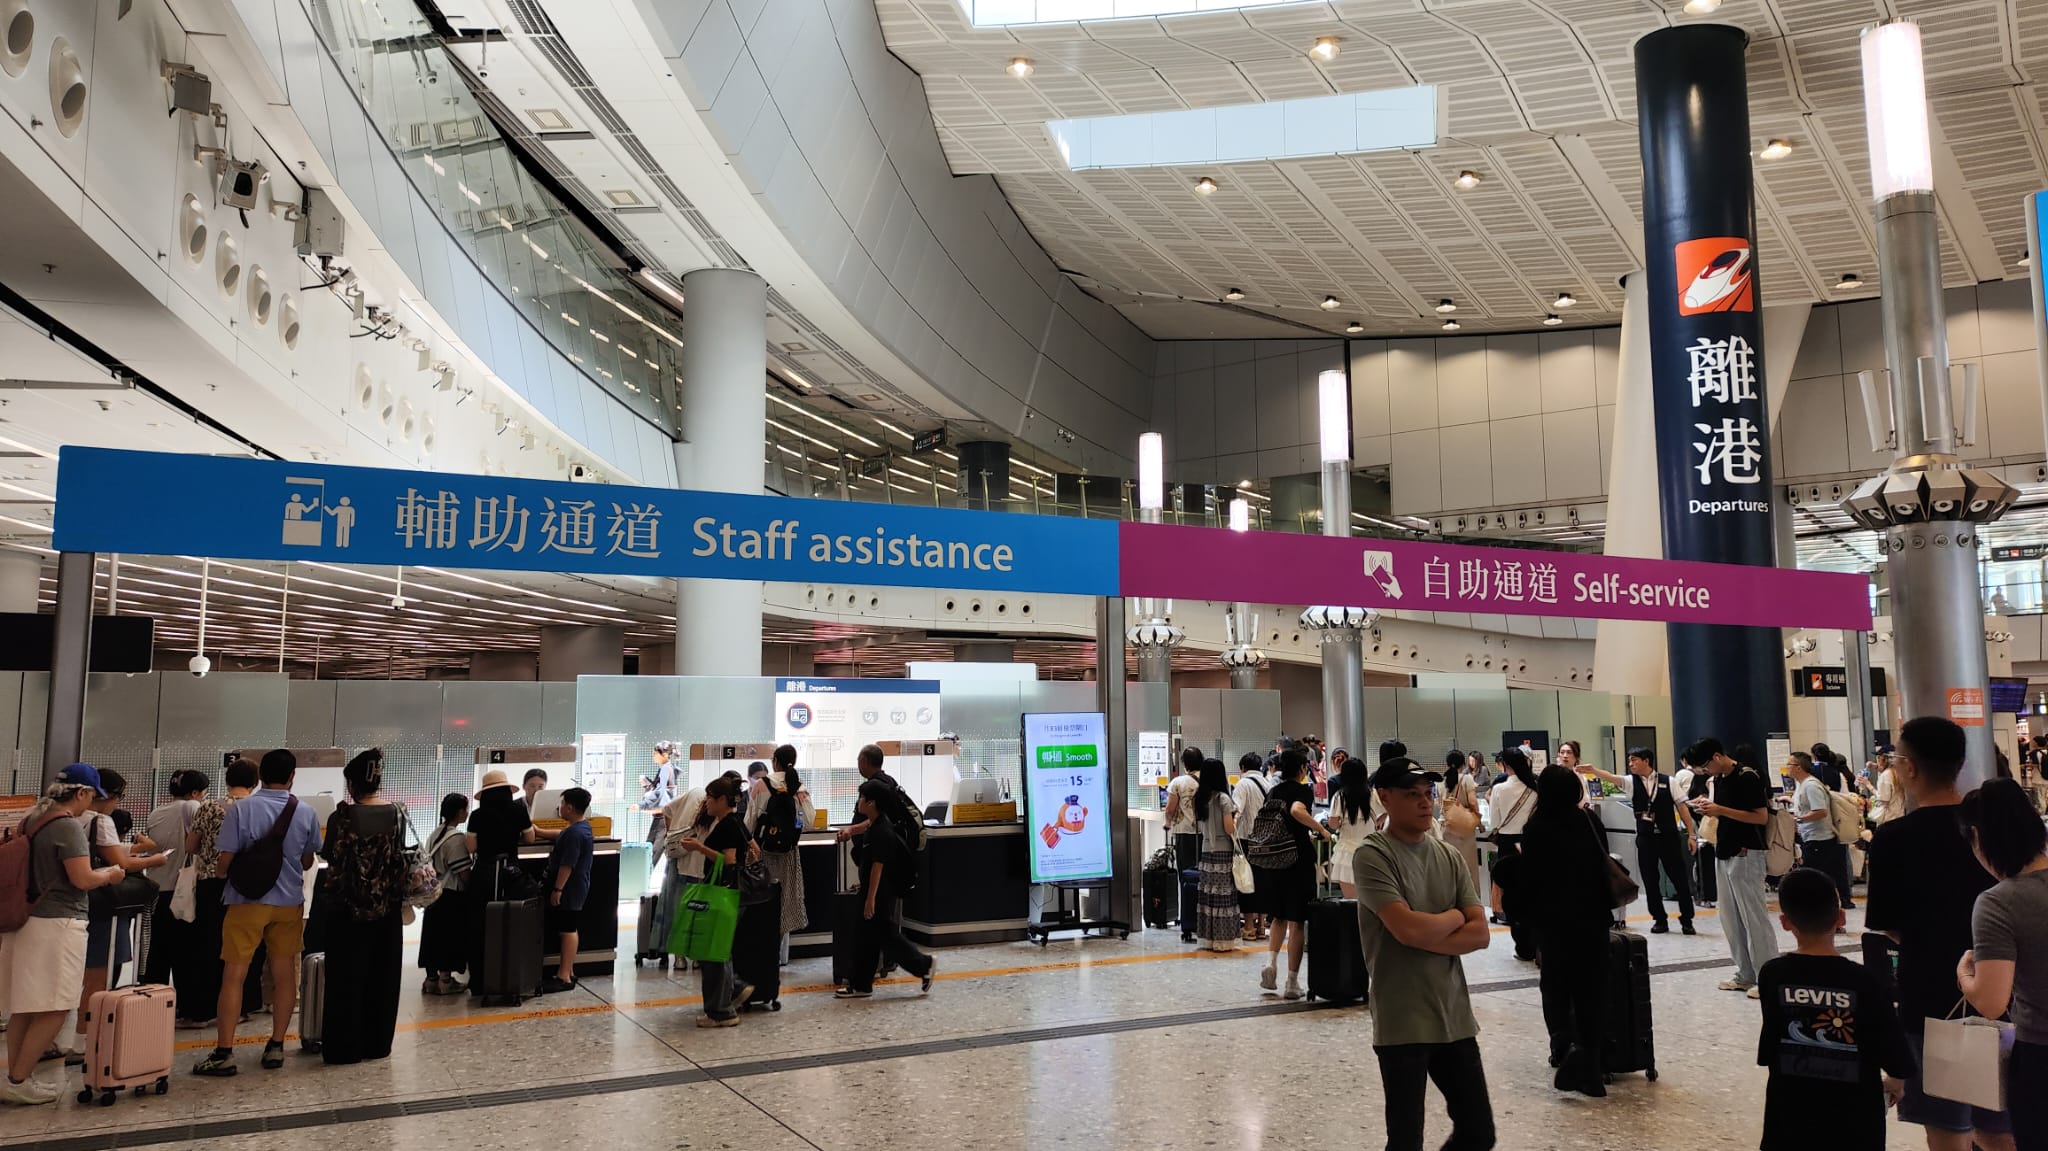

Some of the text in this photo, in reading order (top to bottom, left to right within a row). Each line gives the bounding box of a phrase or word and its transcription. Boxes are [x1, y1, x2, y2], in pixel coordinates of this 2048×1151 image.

[1686, 335, 1762, 485] 離港
[1689, 498, 1770, 517] Departures
[394, 486, 1014, 573] 輔助通道 Staff assistance
[1422, 556, 1713, 610] 自助通道 Self-service
[727, 748, 733, 757] 5
[927, 745, 933, 754] 6
[494, 752, 501, 761] 4
[1065, 752, 1093, 762] Smooth
[1070, 775, 1083, 786] 15
